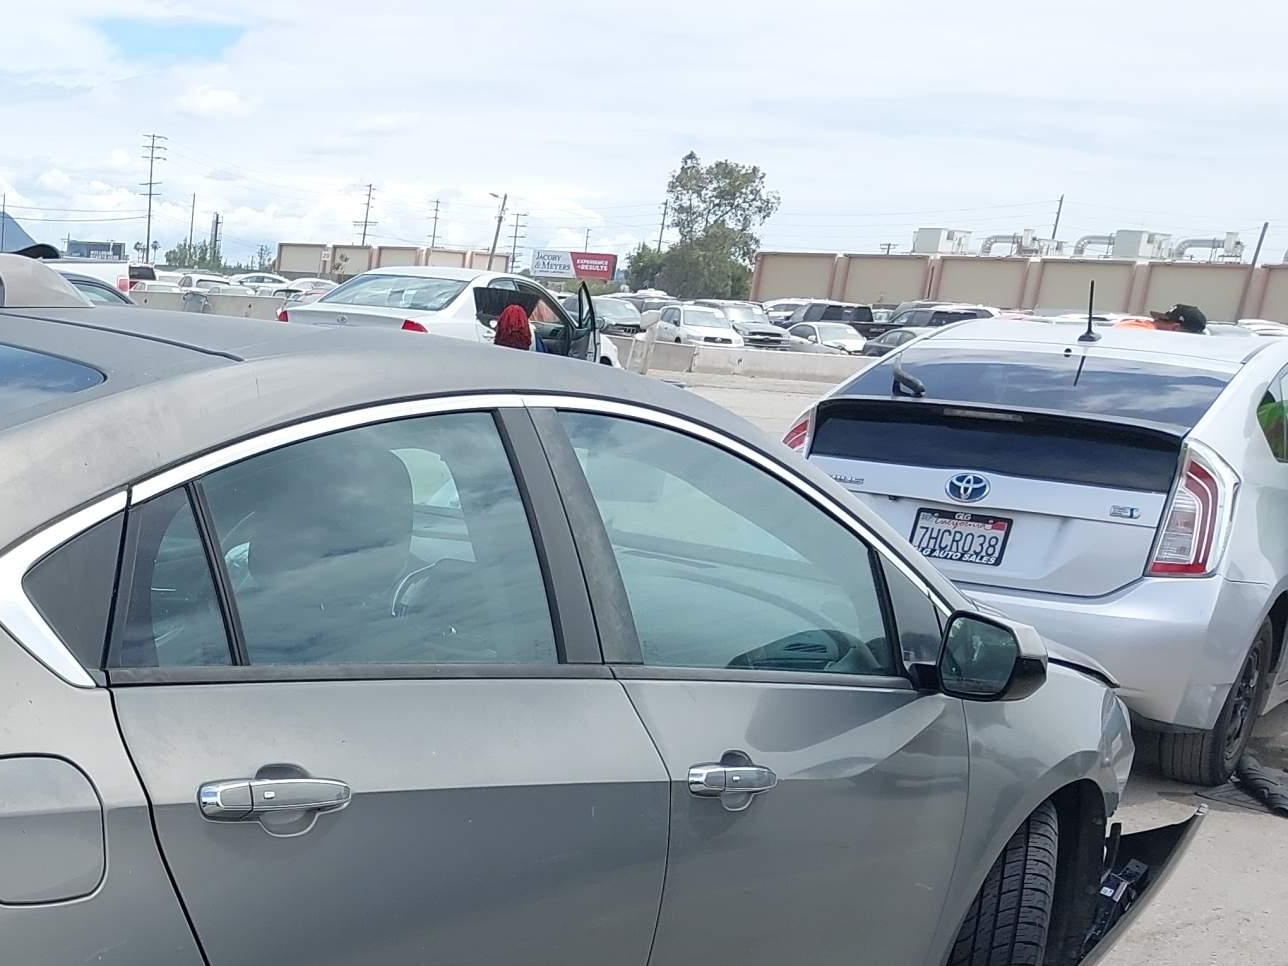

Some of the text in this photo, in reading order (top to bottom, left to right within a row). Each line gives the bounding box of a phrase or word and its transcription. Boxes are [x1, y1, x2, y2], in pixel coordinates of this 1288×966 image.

[535, 260, 570, 271] & MEYERS
[918, 526, 999, 557] 7HCR038
[933, 550, 961, 560] AUTO
[962, 553, 997, 565] SALES
